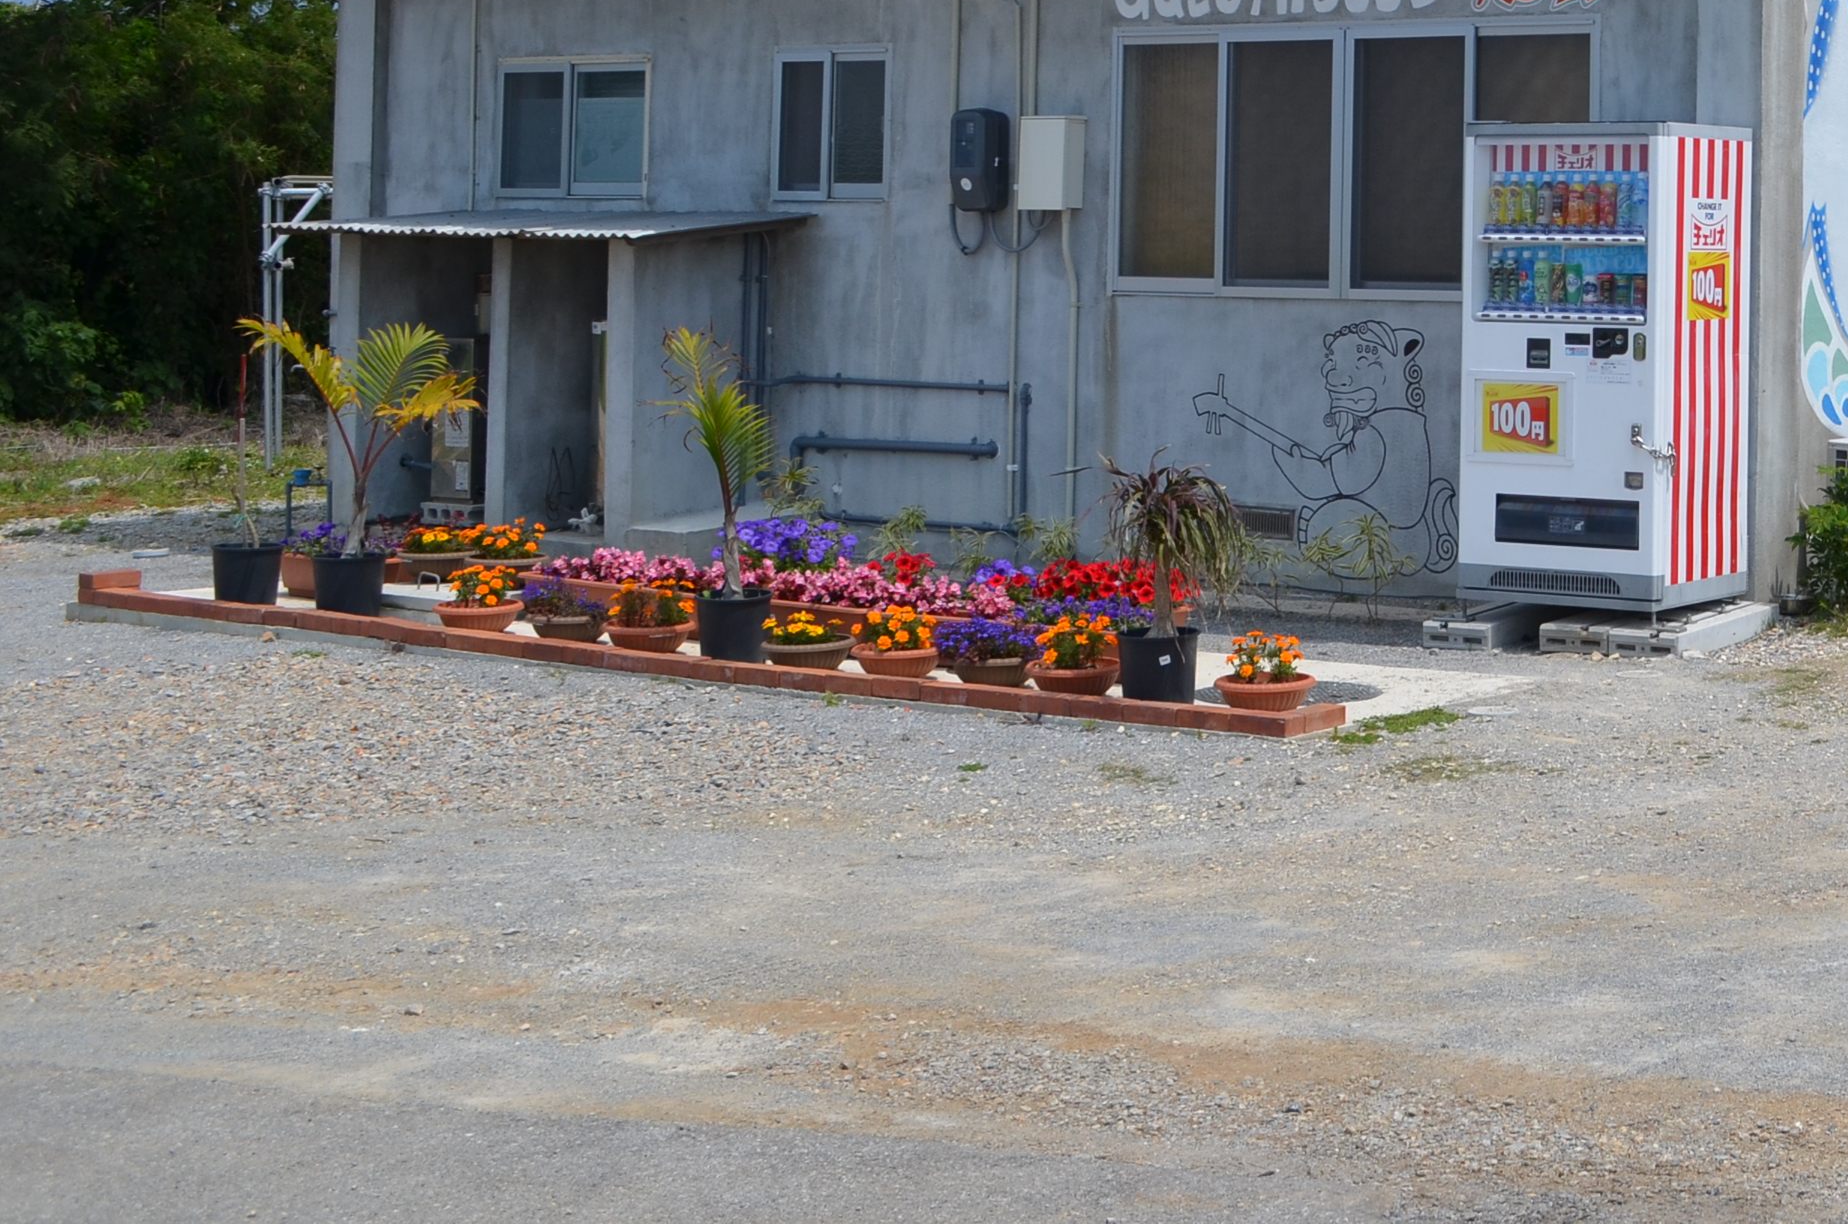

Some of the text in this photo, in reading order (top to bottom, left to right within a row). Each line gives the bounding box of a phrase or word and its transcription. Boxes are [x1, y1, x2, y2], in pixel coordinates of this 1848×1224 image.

[1557, 155, 1594, 170] チェリオ
[1697, 202, 1716, 211] CHANGE
[1704, 212, 1714, 220] FOR
[1693, 222, 1725, 246] チェリオ
[1692, 268, 1723, 307] 100円
[1491, 401, 1545, 441] 100円
